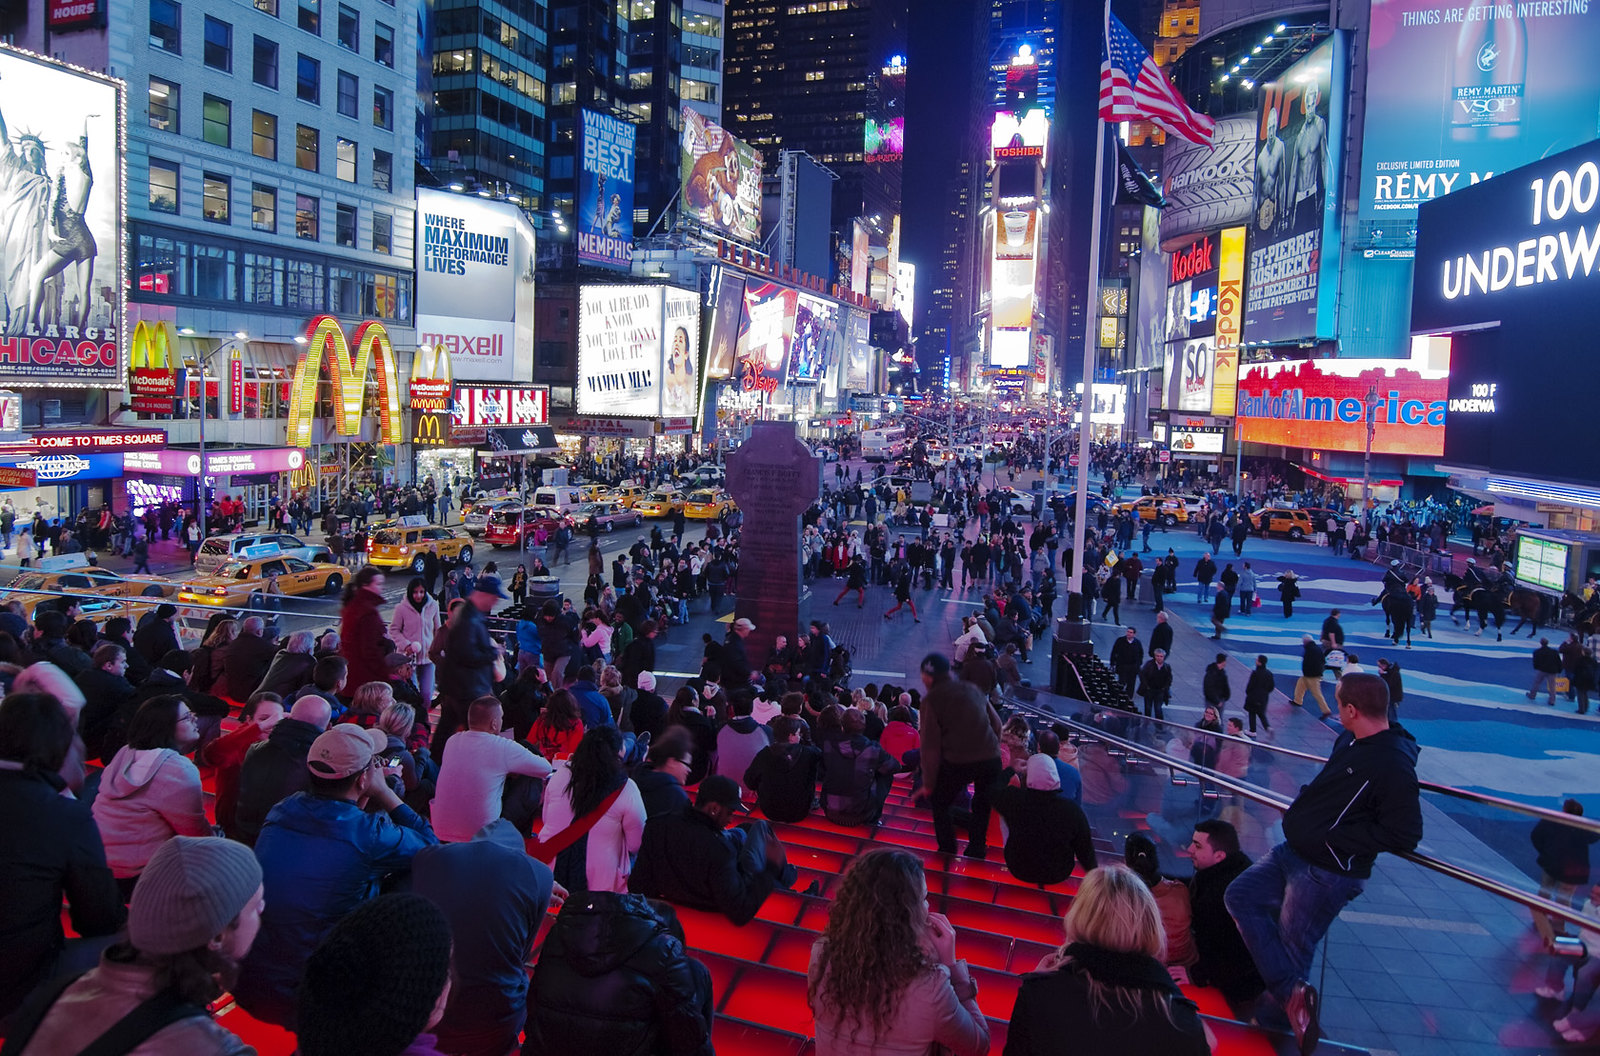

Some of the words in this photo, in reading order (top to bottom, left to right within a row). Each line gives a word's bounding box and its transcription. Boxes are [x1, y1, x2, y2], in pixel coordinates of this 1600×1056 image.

[53, 3, 94, 19] HOURS
[1402, 10, 1440, 26] THINGS
[1444, 8, 1464, 23] ARE
[1468, 4, 1513, 21] GETTING
[1517, 0, 1588, 18] INTERESTING
[1457, 98, 1516, 113] VSOP
[582, 108, 635, 140] WINNER!
[585, 124, 599, 138] 2010
[600, 129, 615, 143] TONY
[615, 134, 633, 149] AWARD
[584, 135, 632, 169] BEST
[994, 147, 1042, 157] TOSHIBA
[584, 157, 632, 183] MUSICAL
[1376, 161, 1408, 171] EXCLUSIVE
[1410, 160, 1434, 169] LIMITED
[1435, 159, 1460, 168] EDITION
[1374, 171, 1460, 200] RÉMY
[1530, 161, 1600, 225] 100
[424, 213, 465, 230] WHERE
[424, 226, 509, 254] MAXIMUM
[578, 232, 633, 261] MEMPHIS
[424, 243, 509, 266] PERFORMANCE
[1171, 236, 1213, 283] Kodak
[1442, 222, 1600, 300] UNDERW
[424, 257, 466, 276] LIVES
[1250, 252, 1310, 289] KOSCHECK
[1310, 249, 1319, 273] 2
[1263, 275, 1307, 298] DECEMBER
[1308, 272, 1317, 288] 11
[586, 300, 603, 316] YOU
[608, 293, 650, 314] ALREADY
[666, 300, 686, 319] MAMMA
[686, 299, 697, 316] MIA!
[1248, 299, 1262, 313] LIVE
[1262, 297, 1270, 310] ON
[1270, 287, 1317, 308] PAY-PER-VIEW
[27, 322, 116, 342] LARGE
[605, 313, 633, 330] KNOW
[1215, 280, 1241, 368] Kodak
[422, 332, 503, 357] maxell
[586, 331, 619, 349] YOU'RE
[623, 327, 657, 343] GONNA
[603, 346, 627, 363] LOVE
[630, 344, 643, 360] IT!
[130, 375, 175, 388] McDonald's
[410, 384, 450, 392] McDonald's
[587, 372, 626, 393] MAMMA
[628, 369, 652, 389] MIA!
[1472, 384, 1488, 397] 100
[1238, 389, 1270, 418] Bank
[1271, 389, 1289, 418] of
[1287, 388, 1446, 426] America
[1449, 399, 1496, 413] UNDERWA
[567, 419, 623, 428] DIGITAL
[77, 436, 91, 446] TO
[93, 434, 123, 446] TIMES
[124, 433, 164, 444] SQUARE
[50, 460, 90, 470] EXCHANGE
[208, 456, 228, 464] TIMES
[228, 455, 252, 464] SQUARE
[208, 463, 234, 472] VISITOR
[234, 462, 256, 471] CENTER
